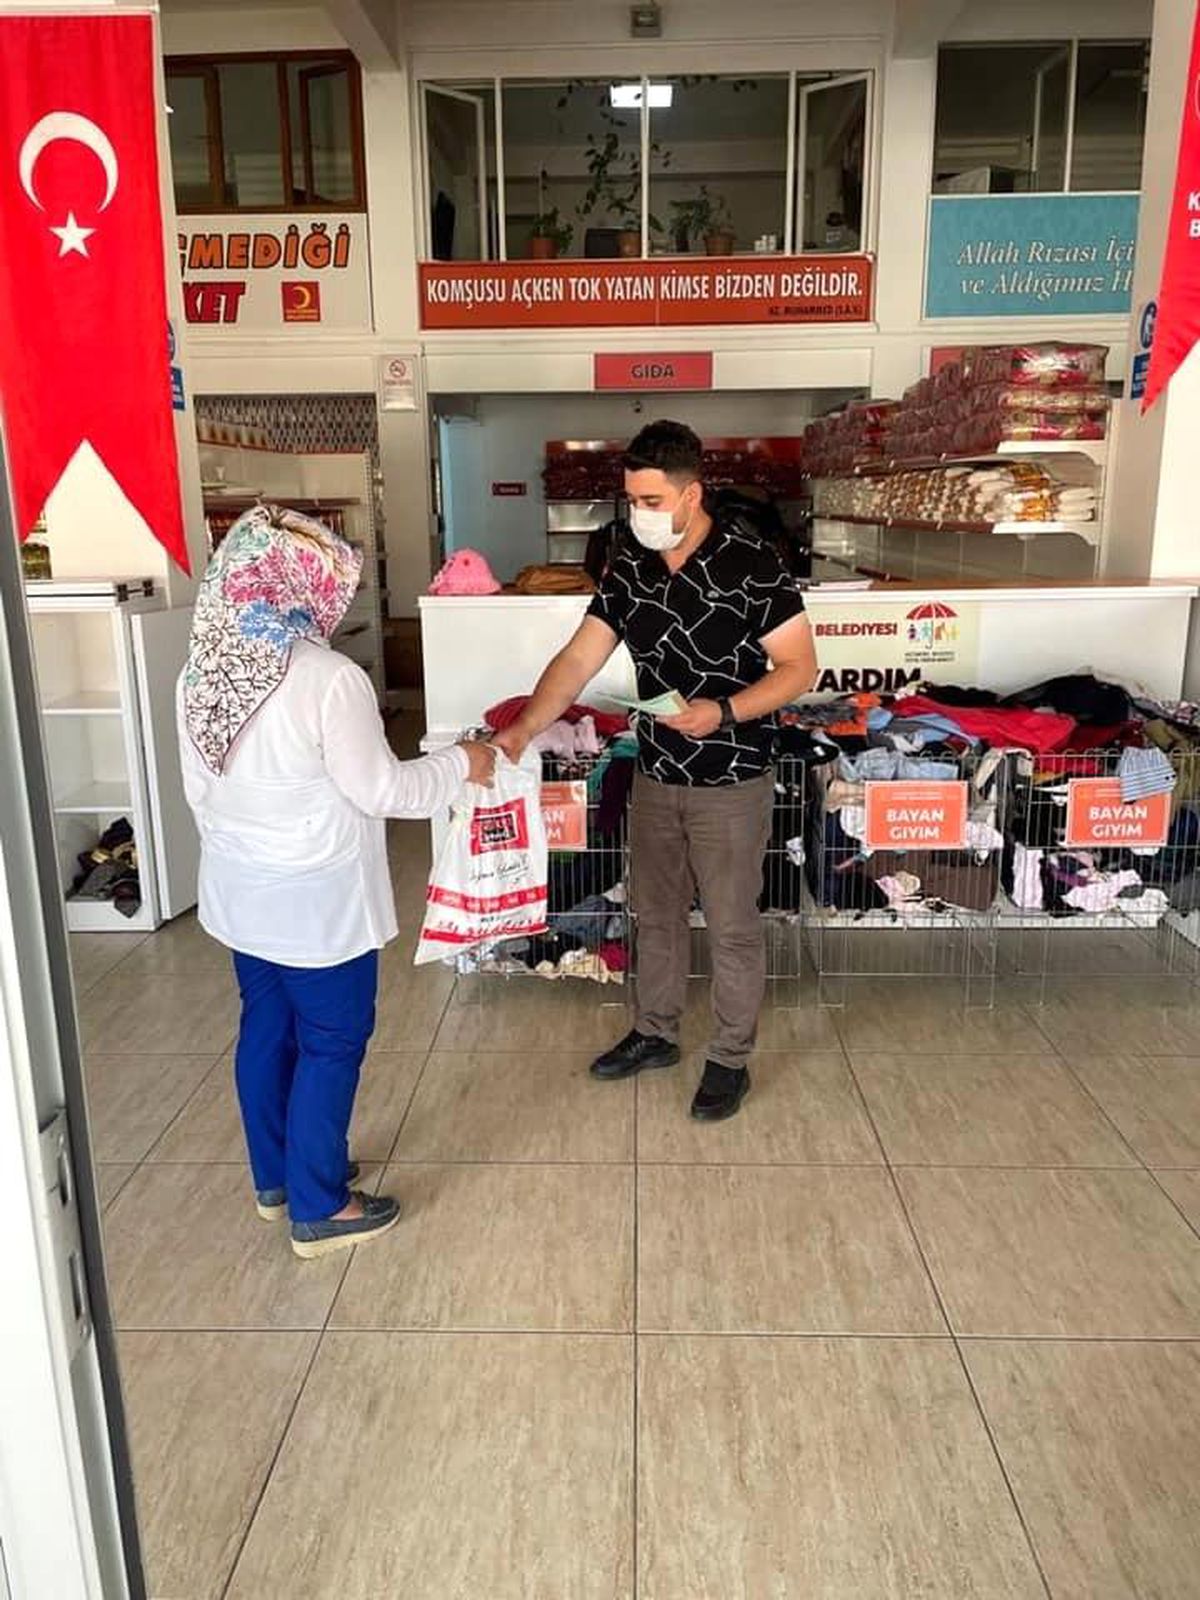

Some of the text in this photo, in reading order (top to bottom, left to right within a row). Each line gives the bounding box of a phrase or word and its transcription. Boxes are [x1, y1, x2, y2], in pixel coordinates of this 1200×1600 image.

[957, 241, 1018, 265] Allah
[1028, 241, 1097, 264] Rızası
[427, 267, 862, 309] KOMŞUSU AÇKEN TOK YATAN KİMSE BİZDEN DEĞİLDİR.
[961, 279, 984, 294] ve
[992, 271, 1105, 300] Aldığımız
[631, 364, 674, 378] GIDA
[809, 668, 921, 692] ARDIM
[886, 808, 944, 822] BAYAN
[1089, 806, 1147, 819] BAYAN
